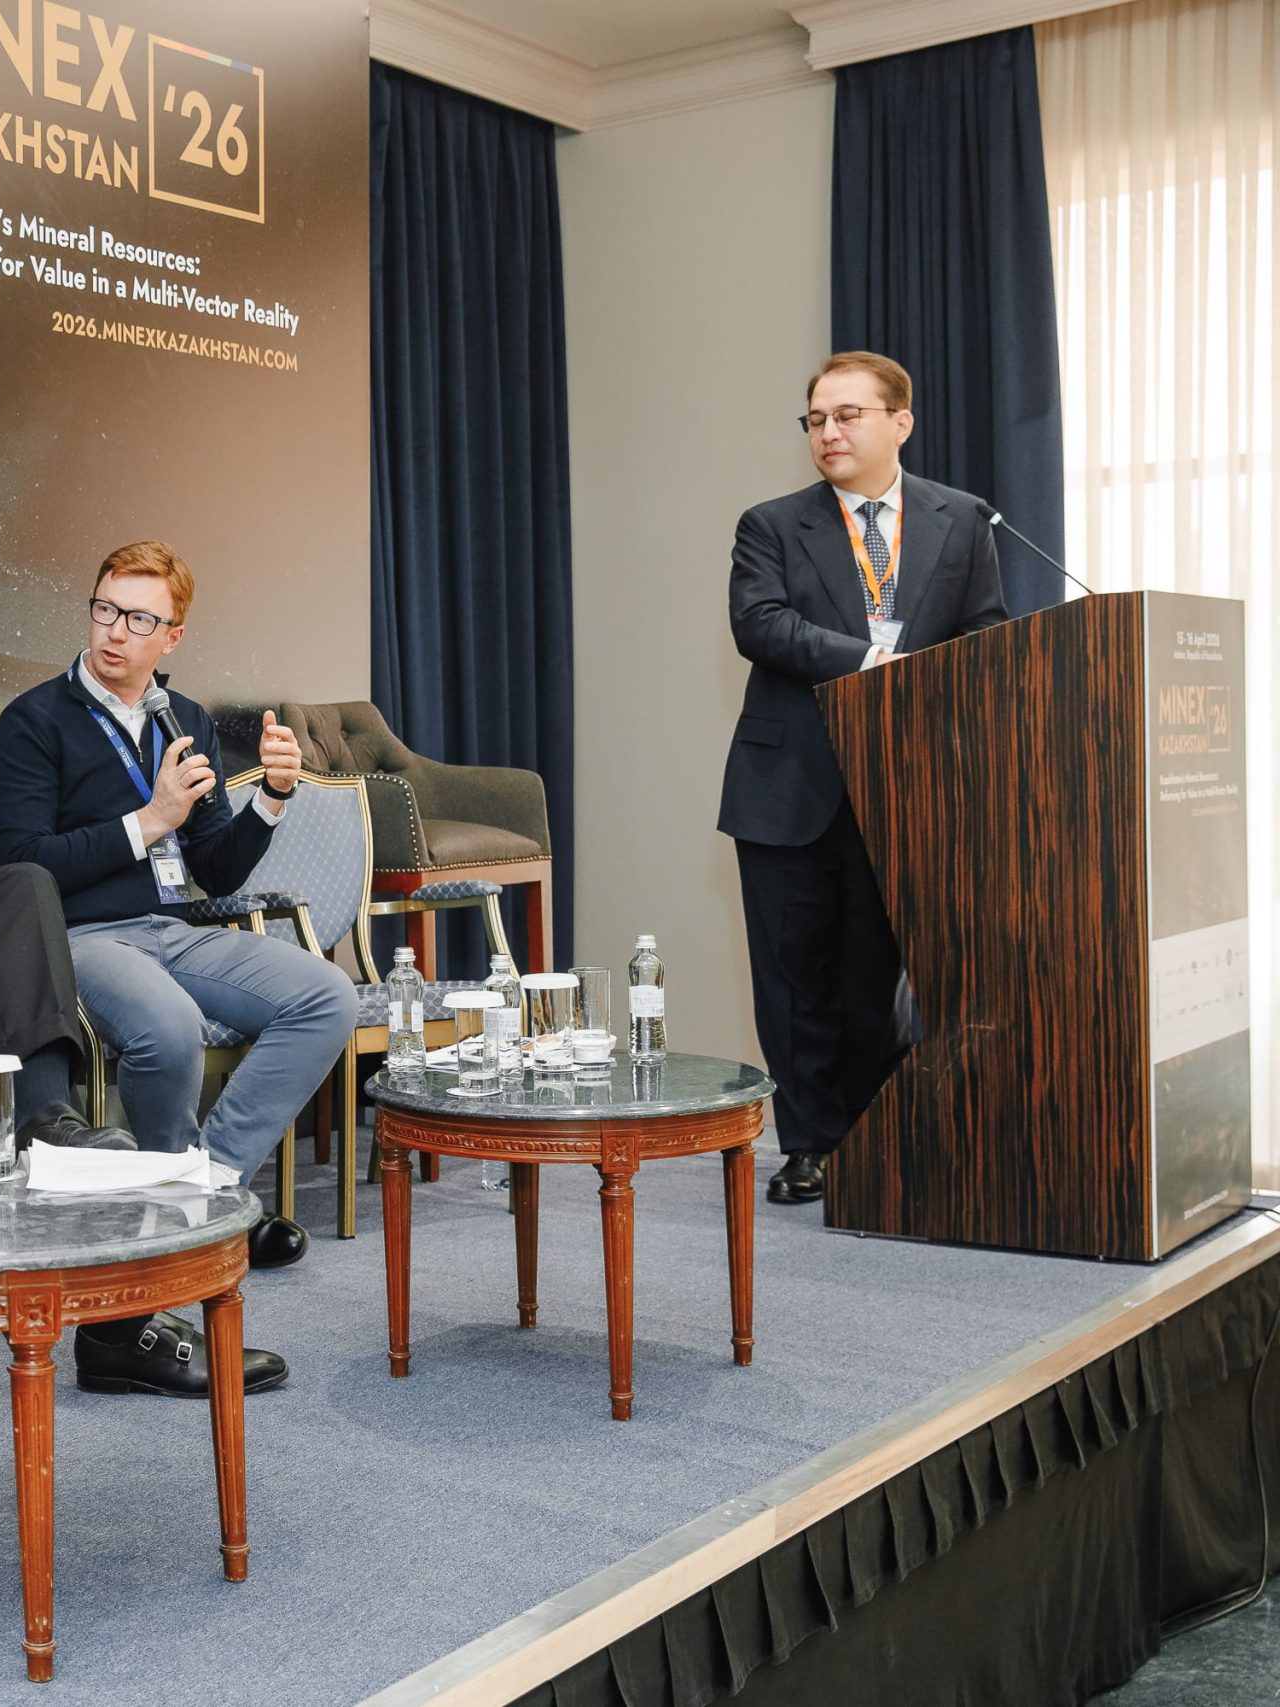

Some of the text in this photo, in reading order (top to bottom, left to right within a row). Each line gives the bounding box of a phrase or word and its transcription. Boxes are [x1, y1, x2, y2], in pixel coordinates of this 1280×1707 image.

[20, 216, 95, 254] Mineral
[101, 237, 200, 276] Resources:
[30, 255, 86, 291] Value
[92, 267, 110, 296] in
[115, 280, 127, 299] a
[132, 277, 239, 321] Multi-Vector
[244, 297, 299, 336] Reality
[52, 311, 299, 373] 2026.MINEXKAZAKHSTAN.COM
[1159, 685, 1206, 726] MINEX
[1159, 734, 1207, 755] KAZAKHSTAN
